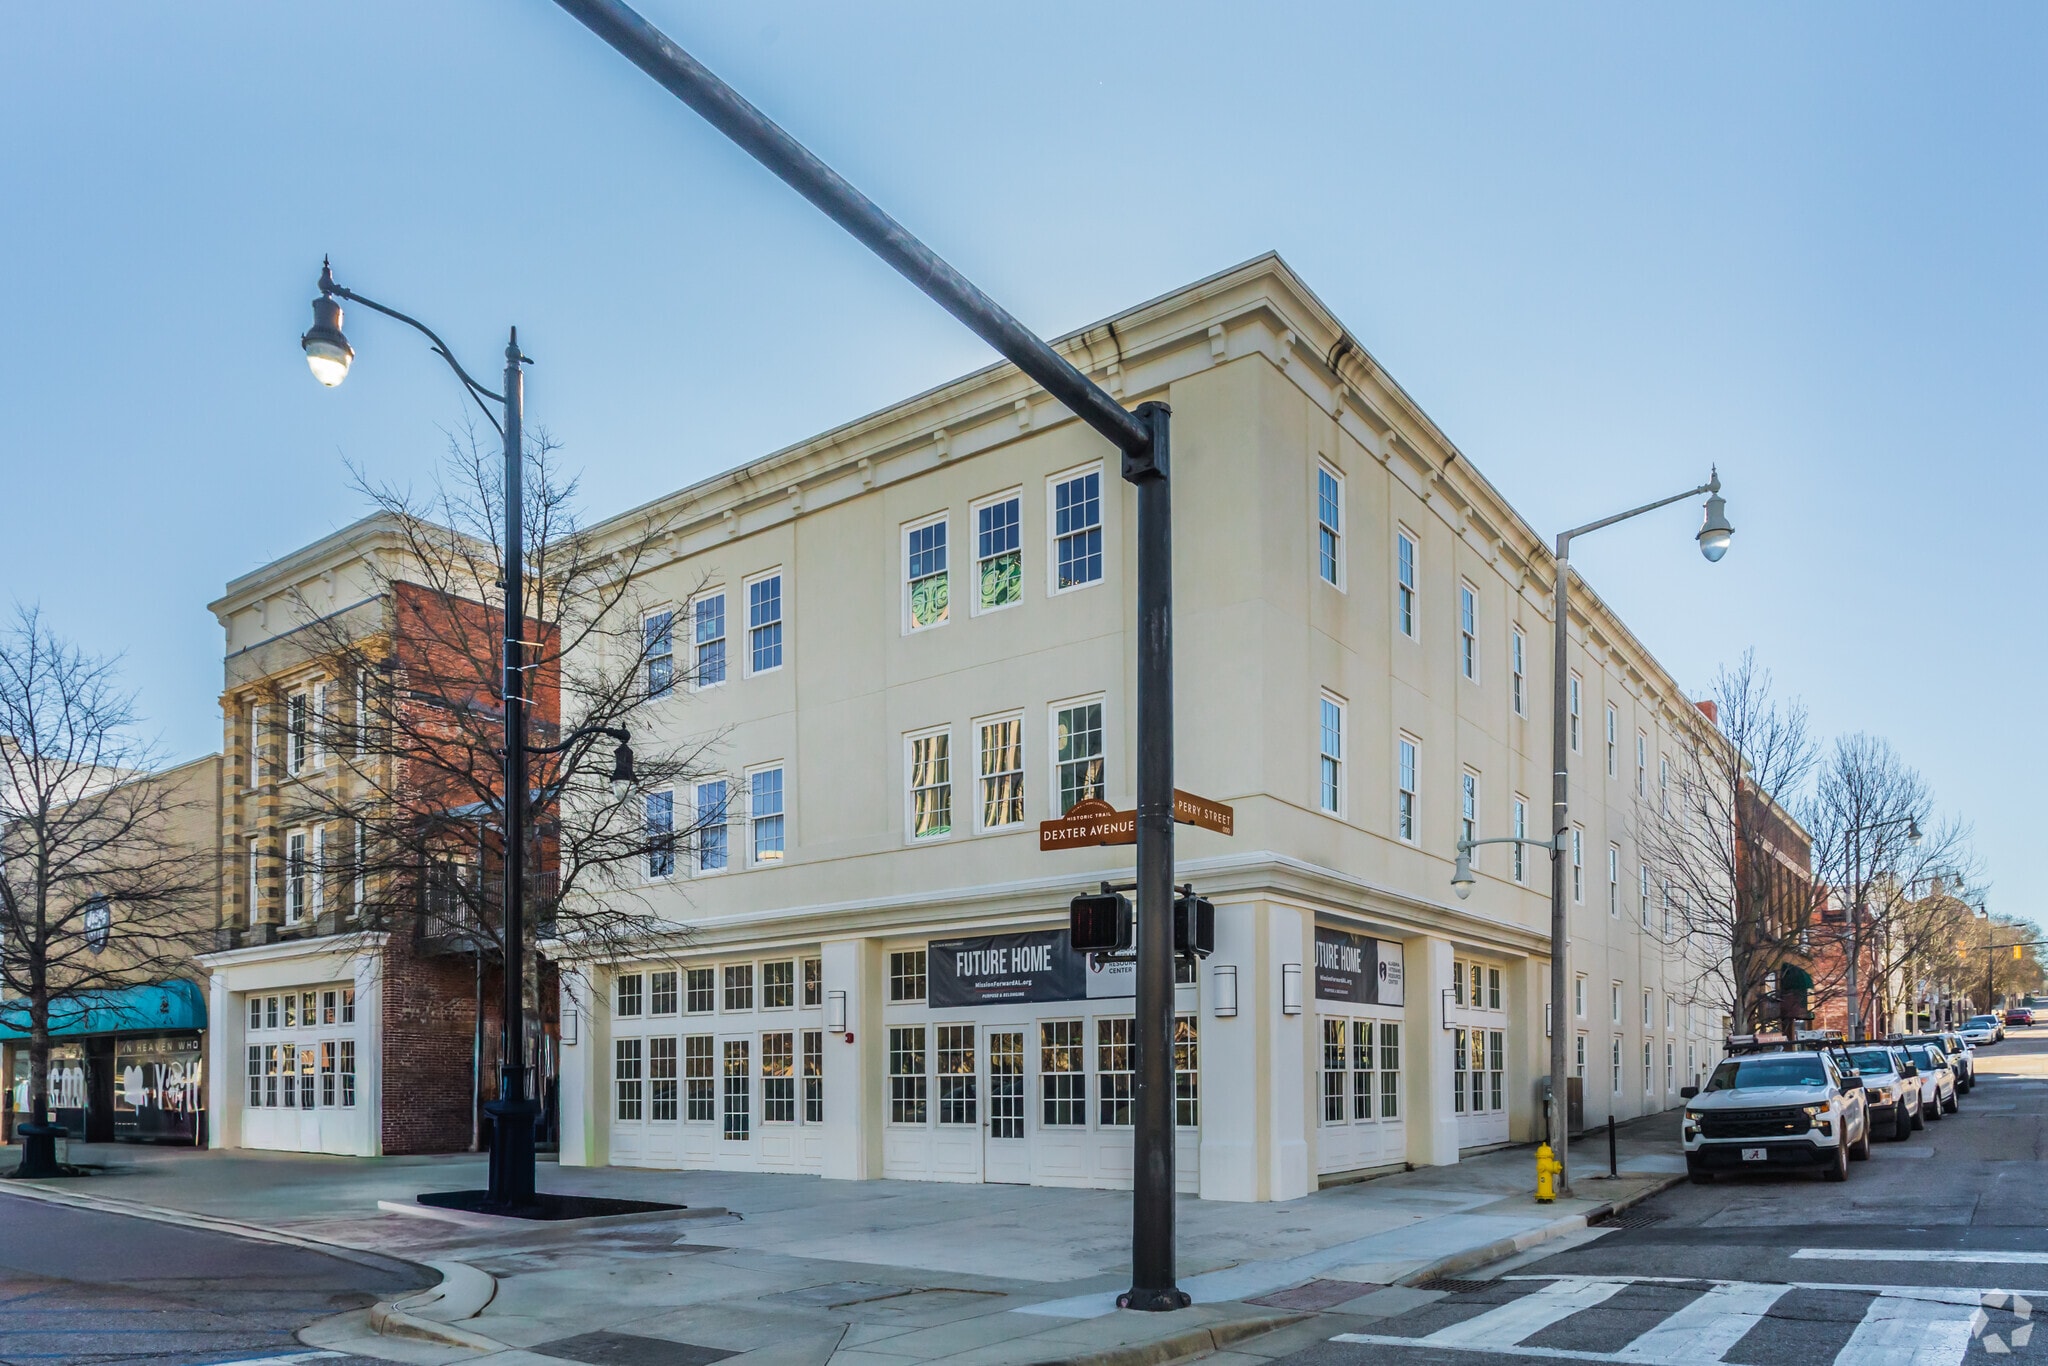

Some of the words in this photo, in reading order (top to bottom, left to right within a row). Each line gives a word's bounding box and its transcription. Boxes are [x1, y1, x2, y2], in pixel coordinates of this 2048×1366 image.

[1178, 800, 1201, 816] PERRY
[1204, 808, 1231, 825] STREET
[1043, 826, 1086, 841] DEXTER
[1090, 820, 1134, 836] AVENUE
[956, 948, 1008, 977] FUTURE
[1012, 945, 1052, 973] HOME
[1314, 941, 1339, 969] UTURE
[1340, 945, 1361, 973] HOME
[123, 1044, 132, 1053] IN
[136, 1041, 173, 1052] HEAVEN
[179, 1040, 198, 1050] WHO
